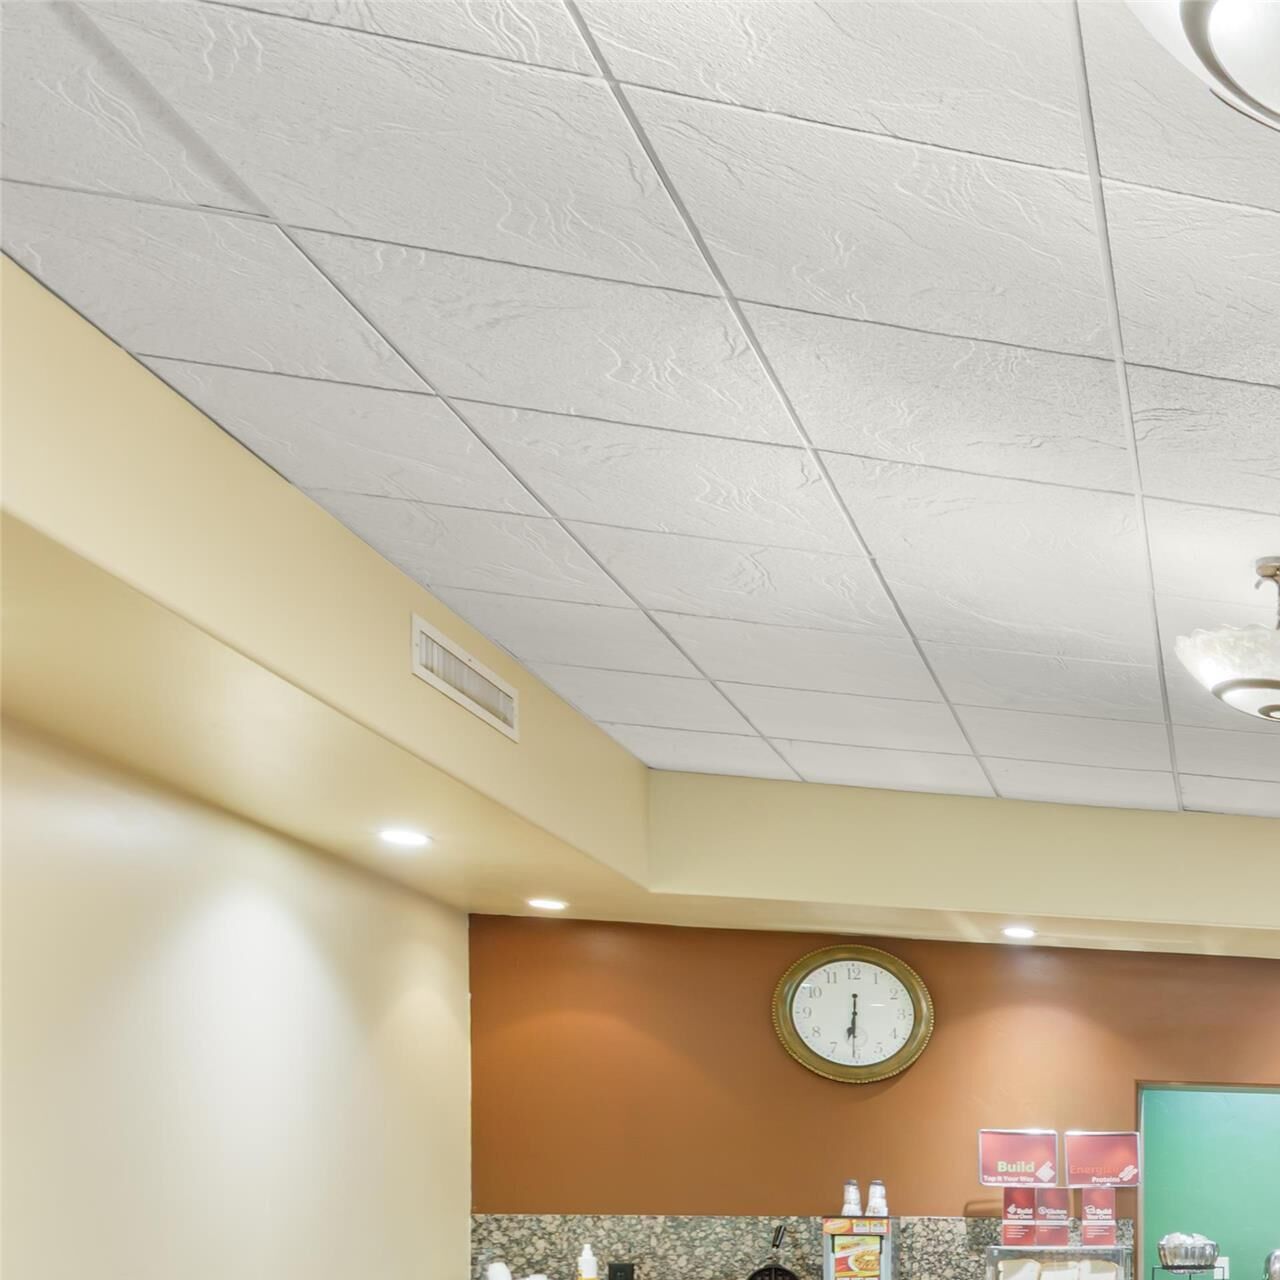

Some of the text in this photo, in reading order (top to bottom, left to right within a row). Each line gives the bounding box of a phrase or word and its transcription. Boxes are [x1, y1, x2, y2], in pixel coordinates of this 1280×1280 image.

[826, 971, 838, 984] 11
[847, 967, 862, 980] 12
[808, 985, 823, 999] 10
[889, 987, 899, 1000] 2
[802, 1006, 812, 1019] 9
[896, 1008, 906, 1021] 3
[811, 1026, 822, 1038] 8
[890, 1027, 897, 1040] 4
[829, 1041, 838, 1053] 7
[873, 1042, 884, 1054] 5
[997, 1160, 1035, 1173] Build
[1019, 1175, 1034, 1183] Way
